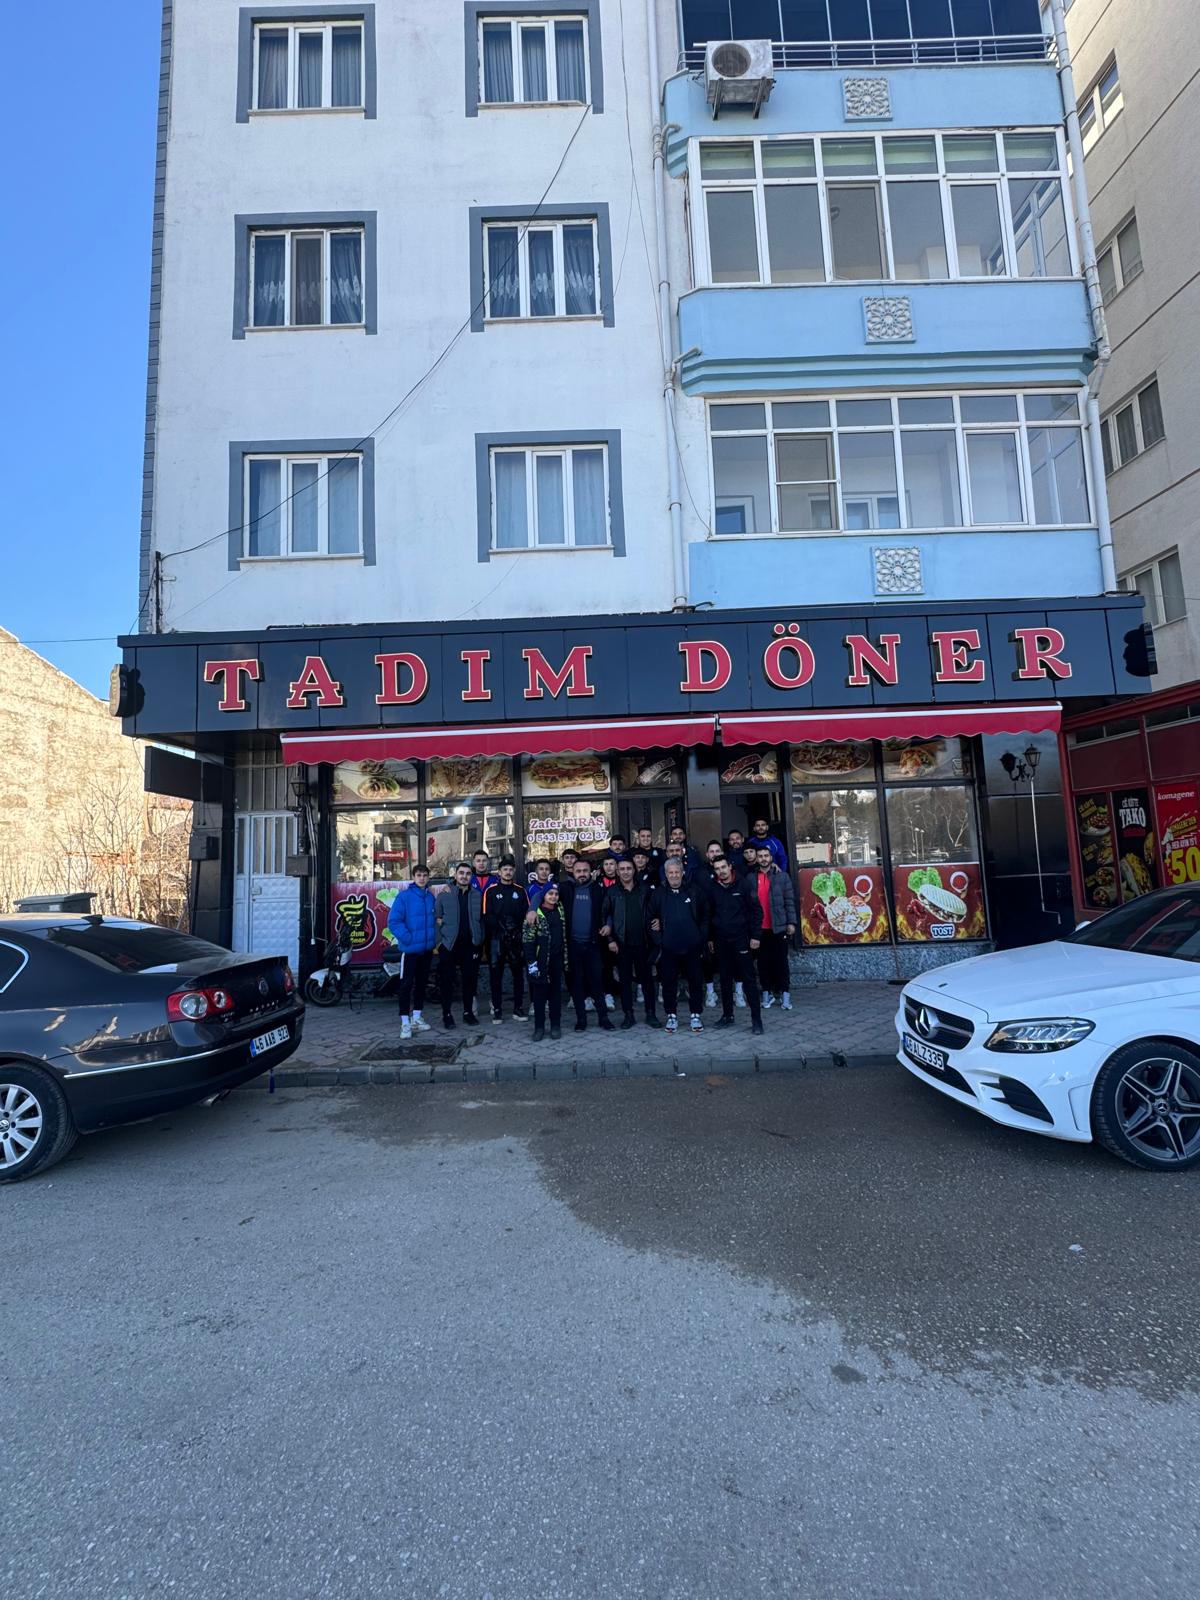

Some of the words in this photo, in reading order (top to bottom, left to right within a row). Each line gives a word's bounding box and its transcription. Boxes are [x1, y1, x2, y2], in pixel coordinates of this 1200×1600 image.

[204, 646, 595, 710] TADIM
[679, 623, 1072, 692] DÖNER
[530, 819, 562, 829] Zafer
[1119, 807, 1146, 829] TAKO
[527, 835, 535, 843] 0
[537, 833, 556, 842] 543
[558, 832, 577, 841] 517
[579, 832, 593, 841] 02
[595, 831, 608, 840] 37
[931, 925, 954, 937] TOST
[254, 1037, 264, 1051] 46
[913, 1042, 928, 1061] ALZ
[928, 1049, 944, 1068] 335
